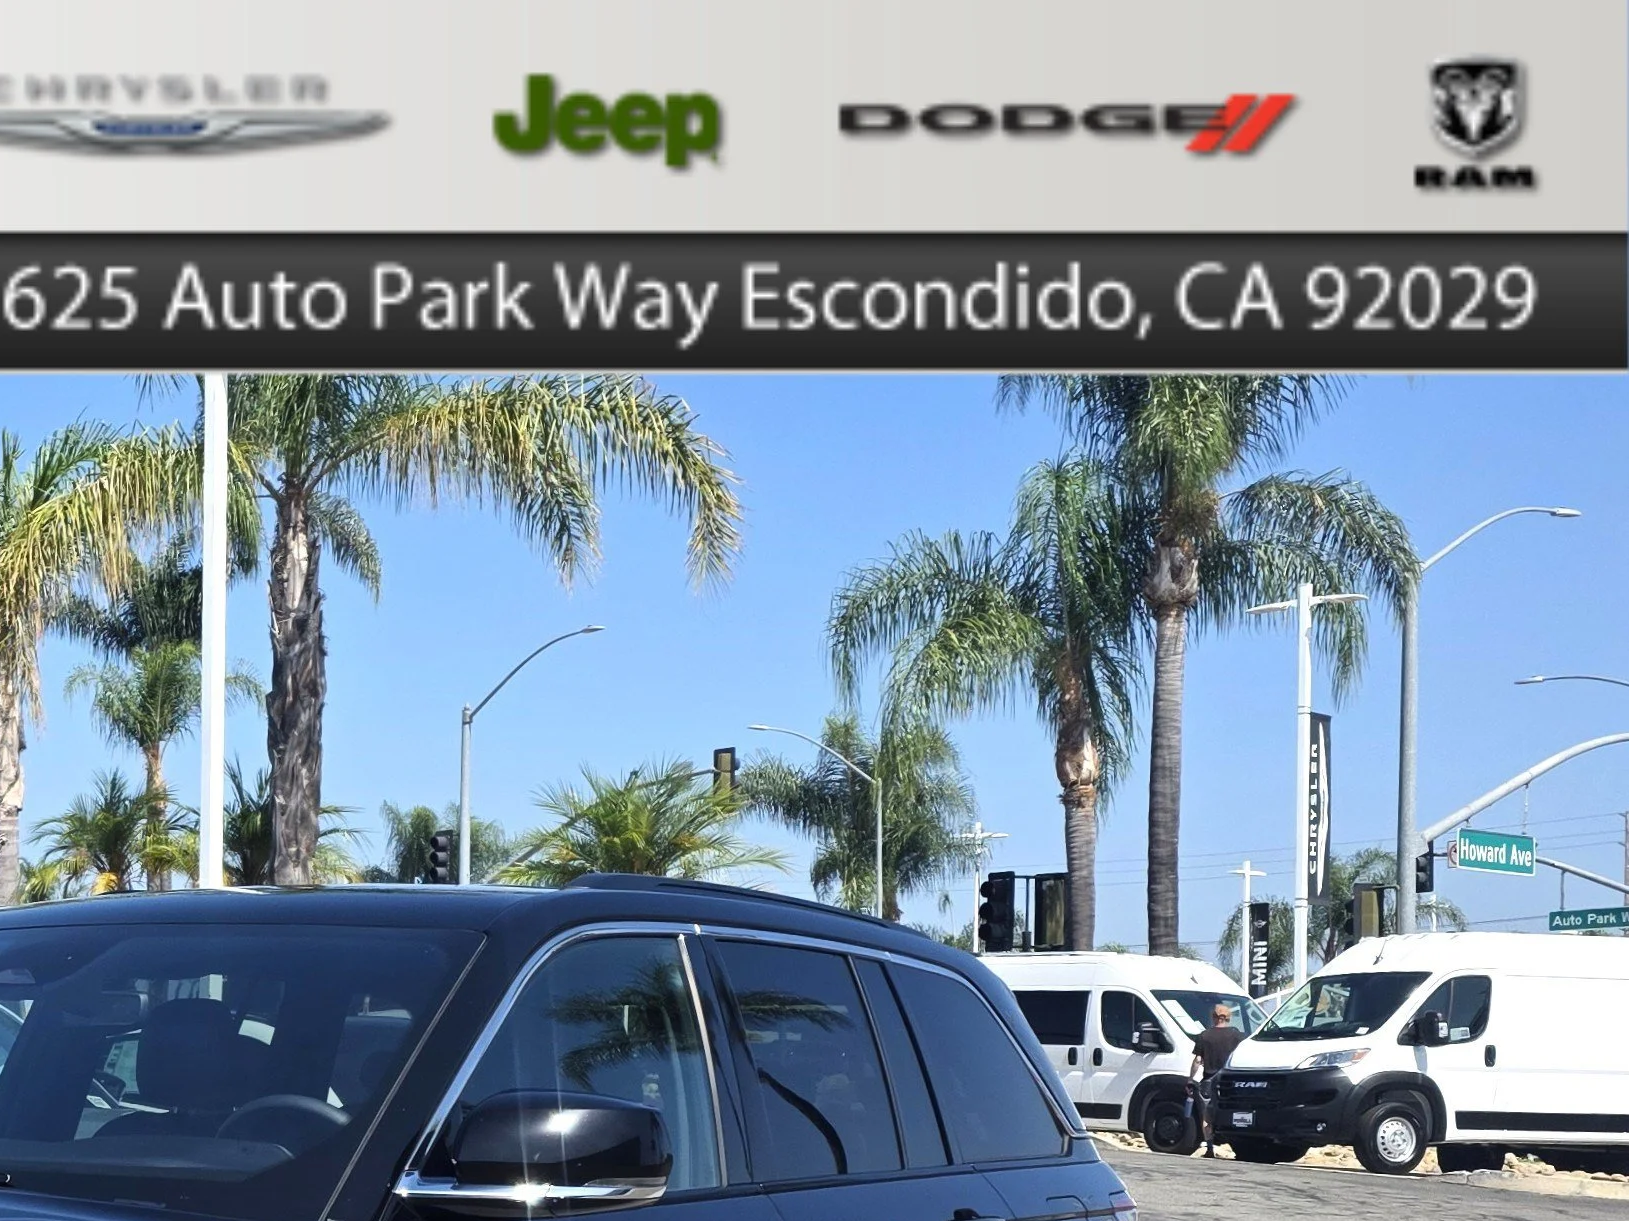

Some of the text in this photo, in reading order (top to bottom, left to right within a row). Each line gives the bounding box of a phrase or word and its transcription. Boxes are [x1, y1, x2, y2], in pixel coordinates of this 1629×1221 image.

[1309, 743, 1318, 875] CHRYSLER
[1460, 838, 1532, 867] Howard Ave
[1552, 915, 1583, 927] Auto
[1587, 912, 1617, 925] Park
[1251, 941, 1267, 986] MINI
